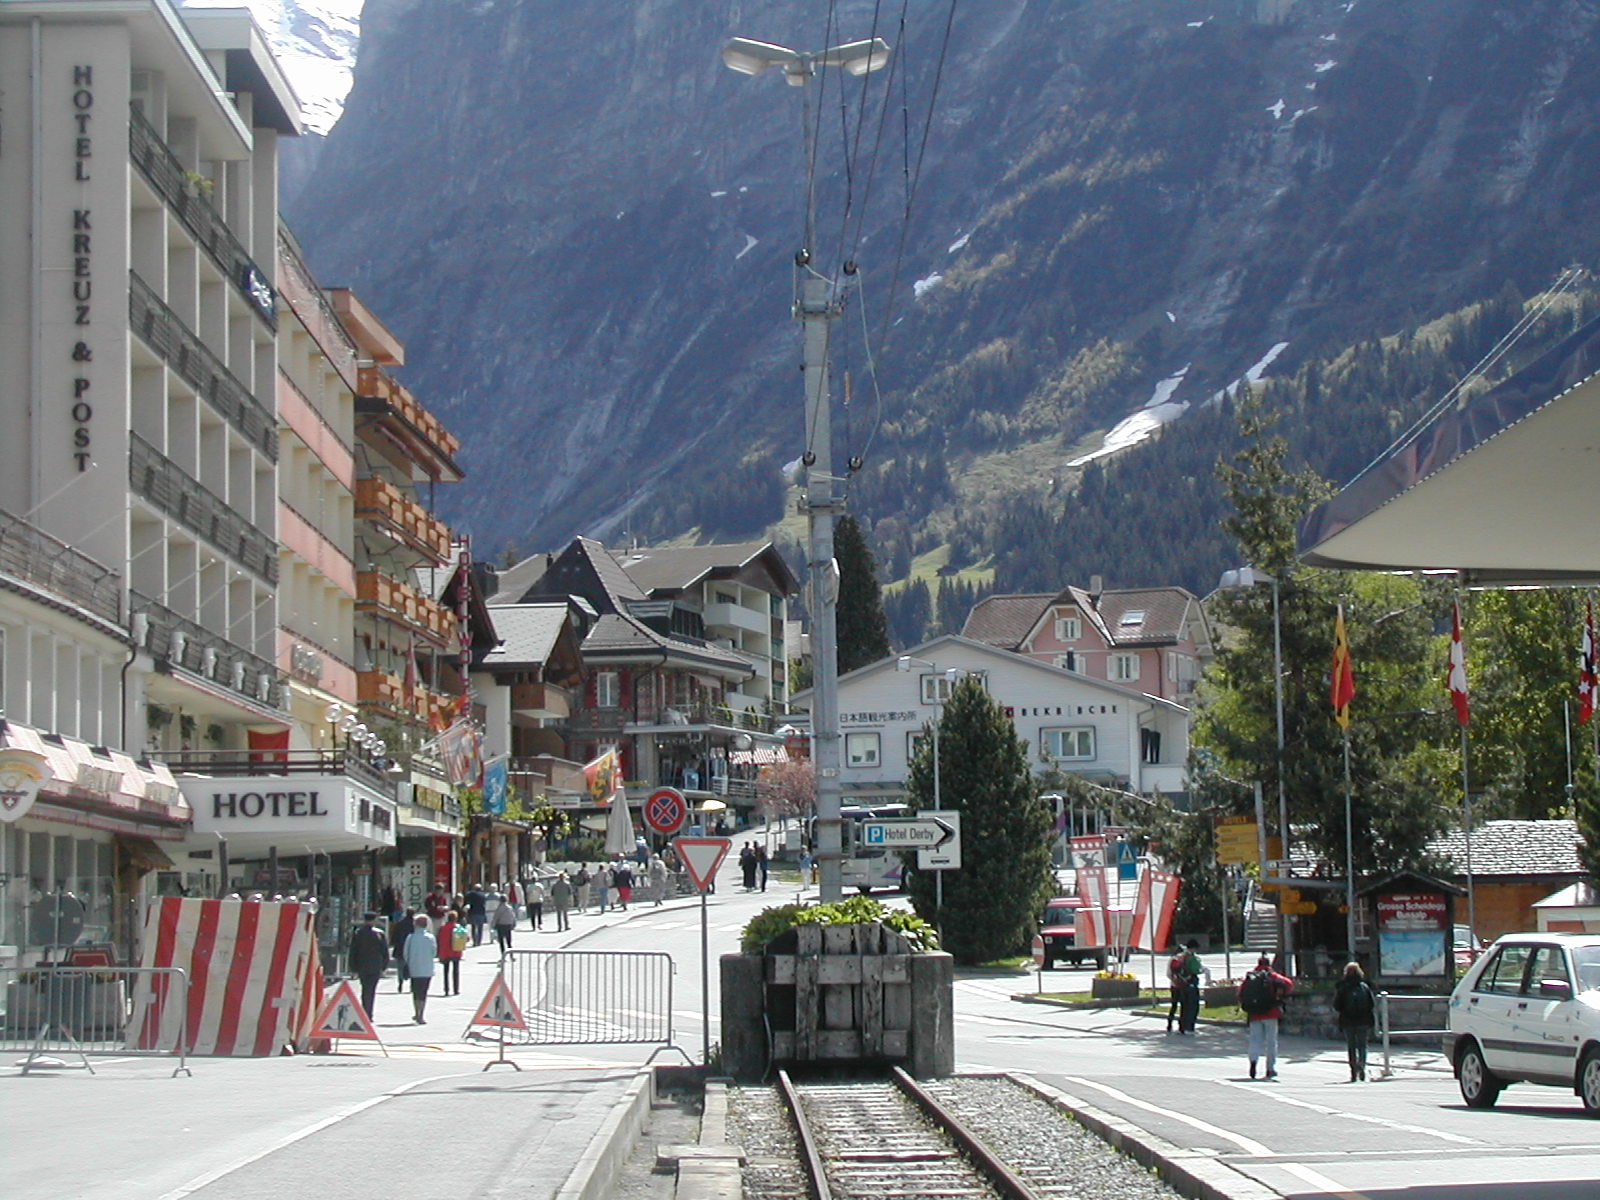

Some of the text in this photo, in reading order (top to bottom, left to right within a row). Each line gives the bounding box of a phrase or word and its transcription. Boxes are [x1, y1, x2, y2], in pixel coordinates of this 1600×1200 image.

[72, 65, 94, 473] HOTEL KREUZ & POST
[456, 534, 473, 620] HOTEL
[1021, 706, 1062, 717] BEKB
[212, 791, 328, 818] HOTEL
[884, 827, 907, 840] Hotel
[909, 827, 934, 841] Derby
[1377, 902, 1405, 911] Grosse
